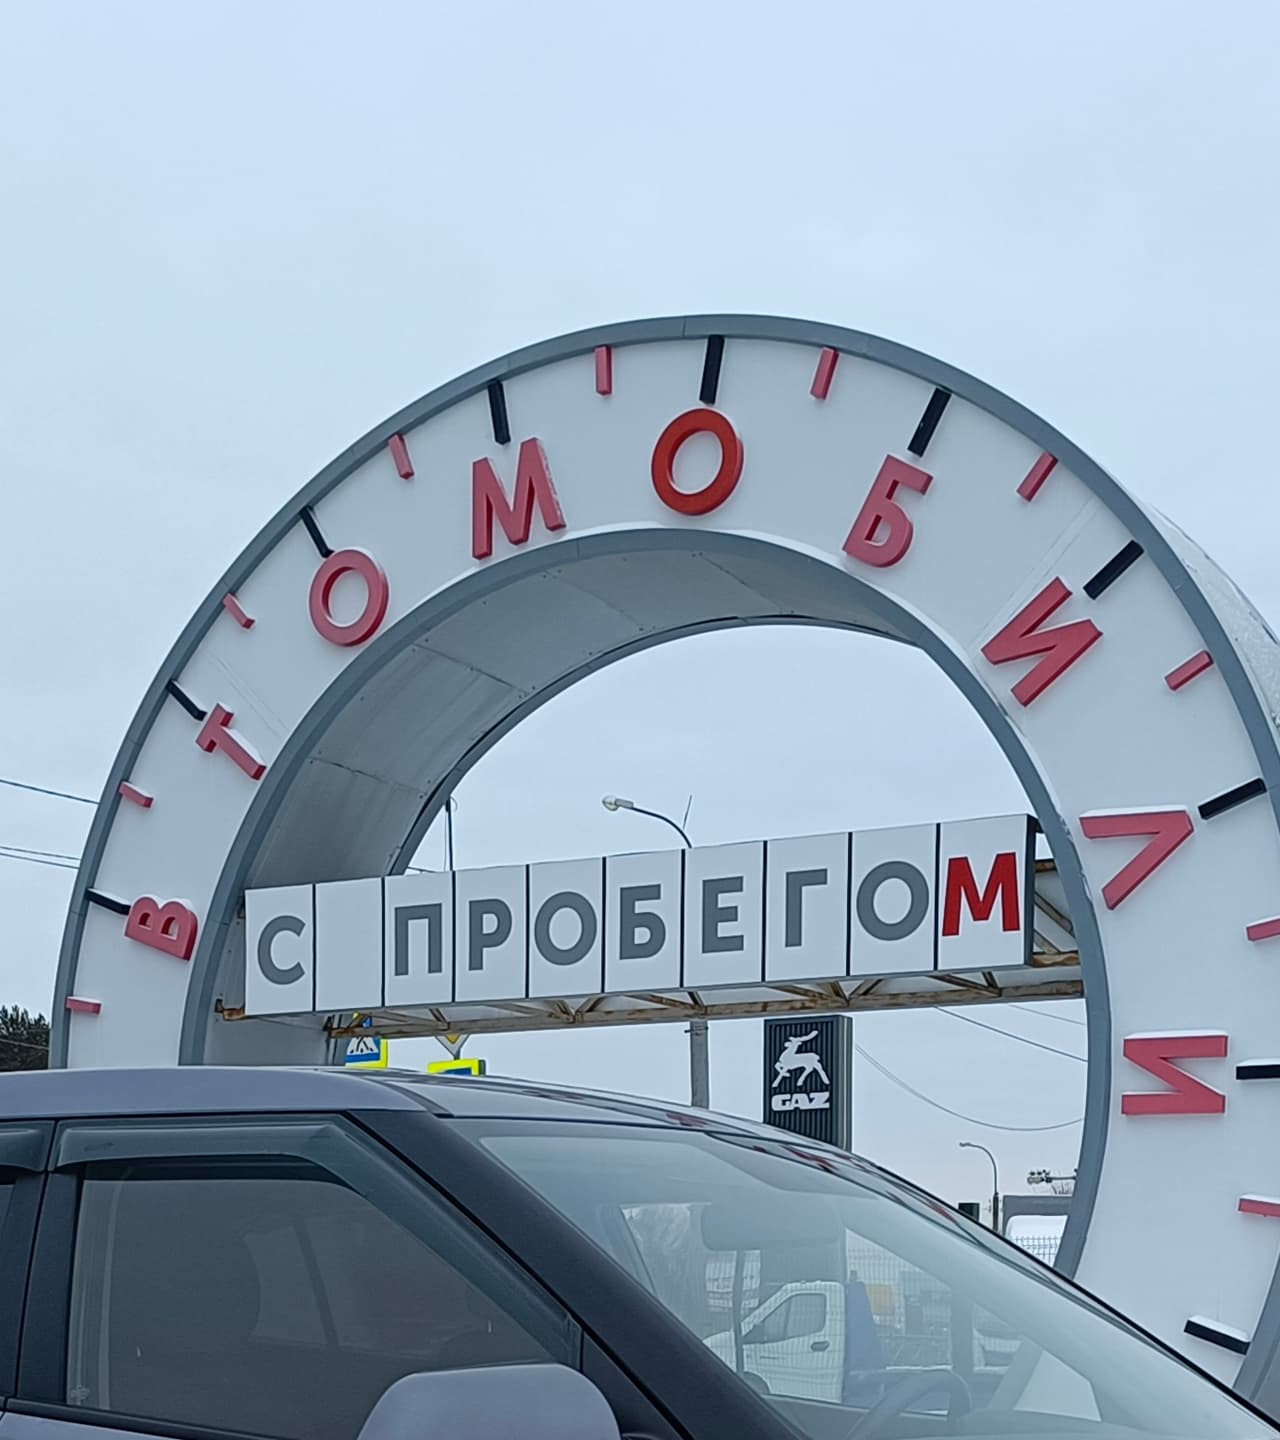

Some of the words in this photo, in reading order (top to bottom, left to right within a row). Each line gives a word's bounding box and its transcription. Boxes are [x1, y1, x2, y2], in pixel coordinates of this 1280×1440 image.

[124, 407, 1230, 1117] ВТОМОБИЛИ
[256, 915, 307, 986] С
[393, 851, 1021, 978] ПРОБЕГОМ
[771, 1091, 830, 1111] GAZ
